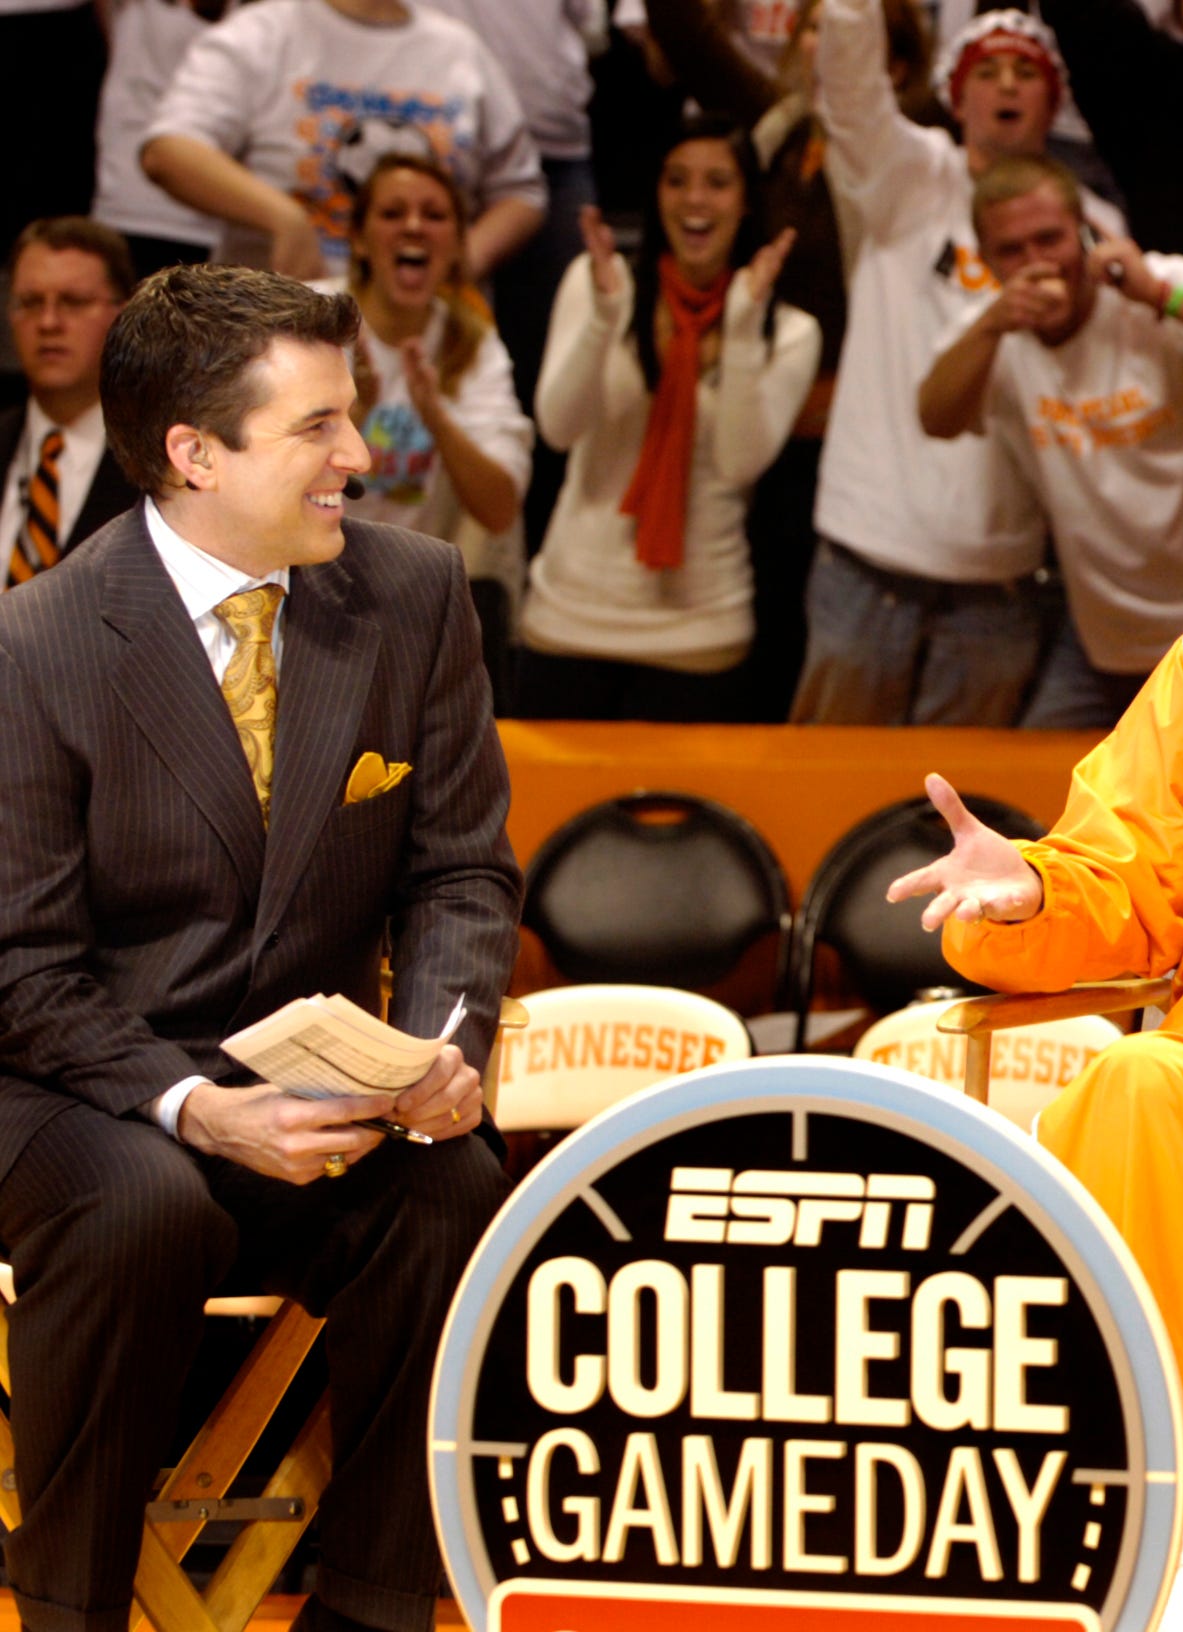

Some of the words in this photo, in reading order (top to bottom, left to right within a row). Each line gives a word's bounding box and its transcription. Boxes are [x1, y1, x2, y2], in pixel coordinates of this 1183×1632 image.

[664, 1166, 936, 1251] ESPN
[526, 1256, 1070, 1433] COLLEGE
[526, 1427, 1069, 1583] GAMEDAY
